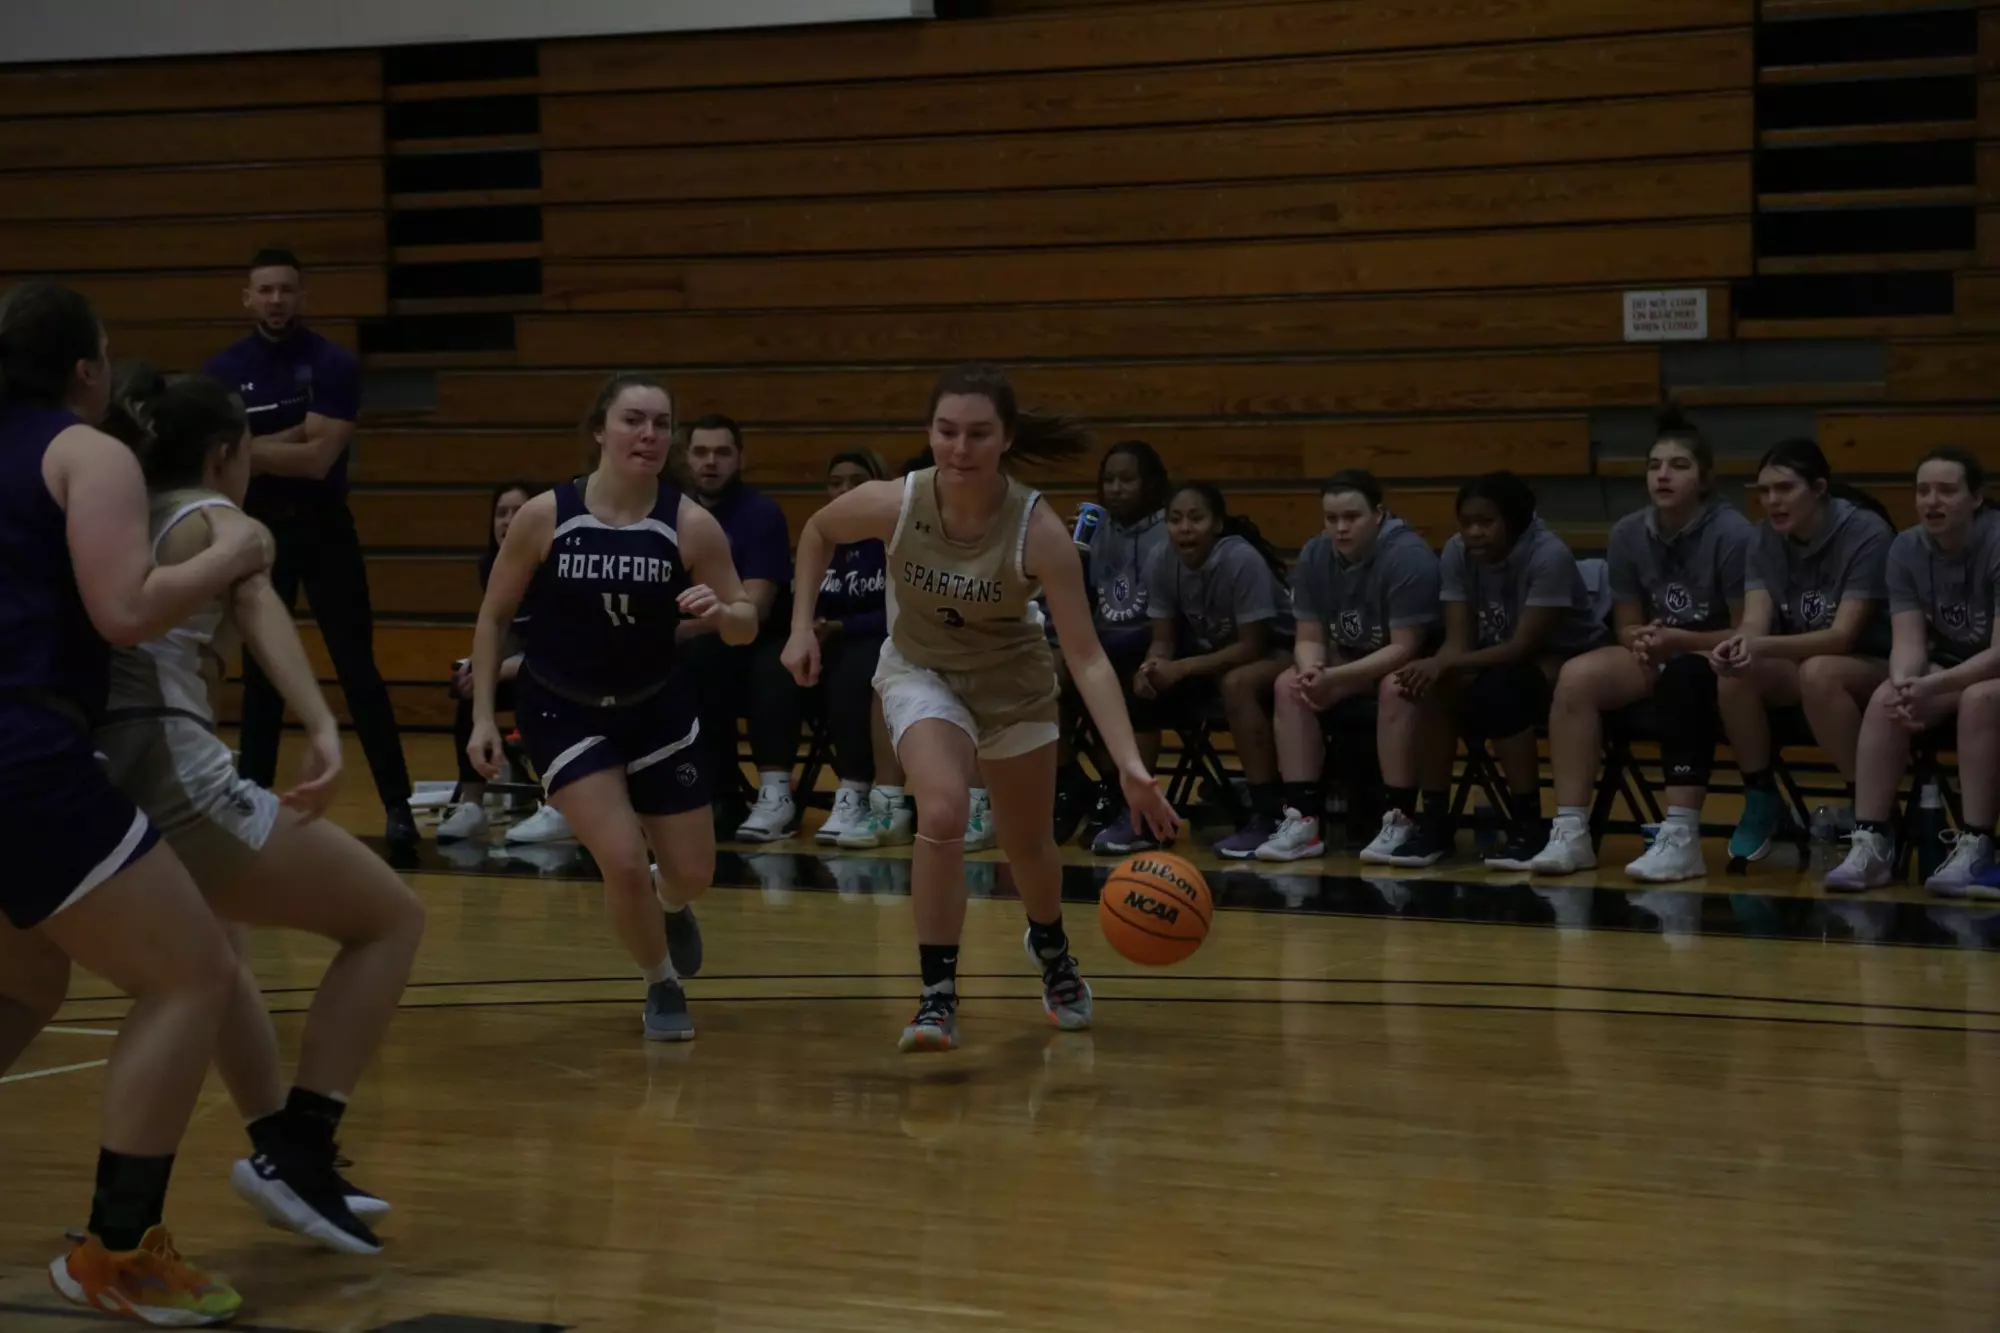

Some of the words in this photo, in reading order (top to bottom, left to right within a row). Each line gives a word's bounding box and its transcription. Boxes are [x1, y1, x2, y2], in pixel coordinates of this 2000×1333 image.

[1632, 298, 1646, 309] DO
[1649, 298, 1667, 308] NOT
[1632, 310, 1646, 320] ON
[557, 553, 673, 583] ROCKFORD
[903, 561, 1003, 603] SPARTANS
[1130, 859, 1198, 902] Wilson
[1123, 890, 1180, 926] NCAA
